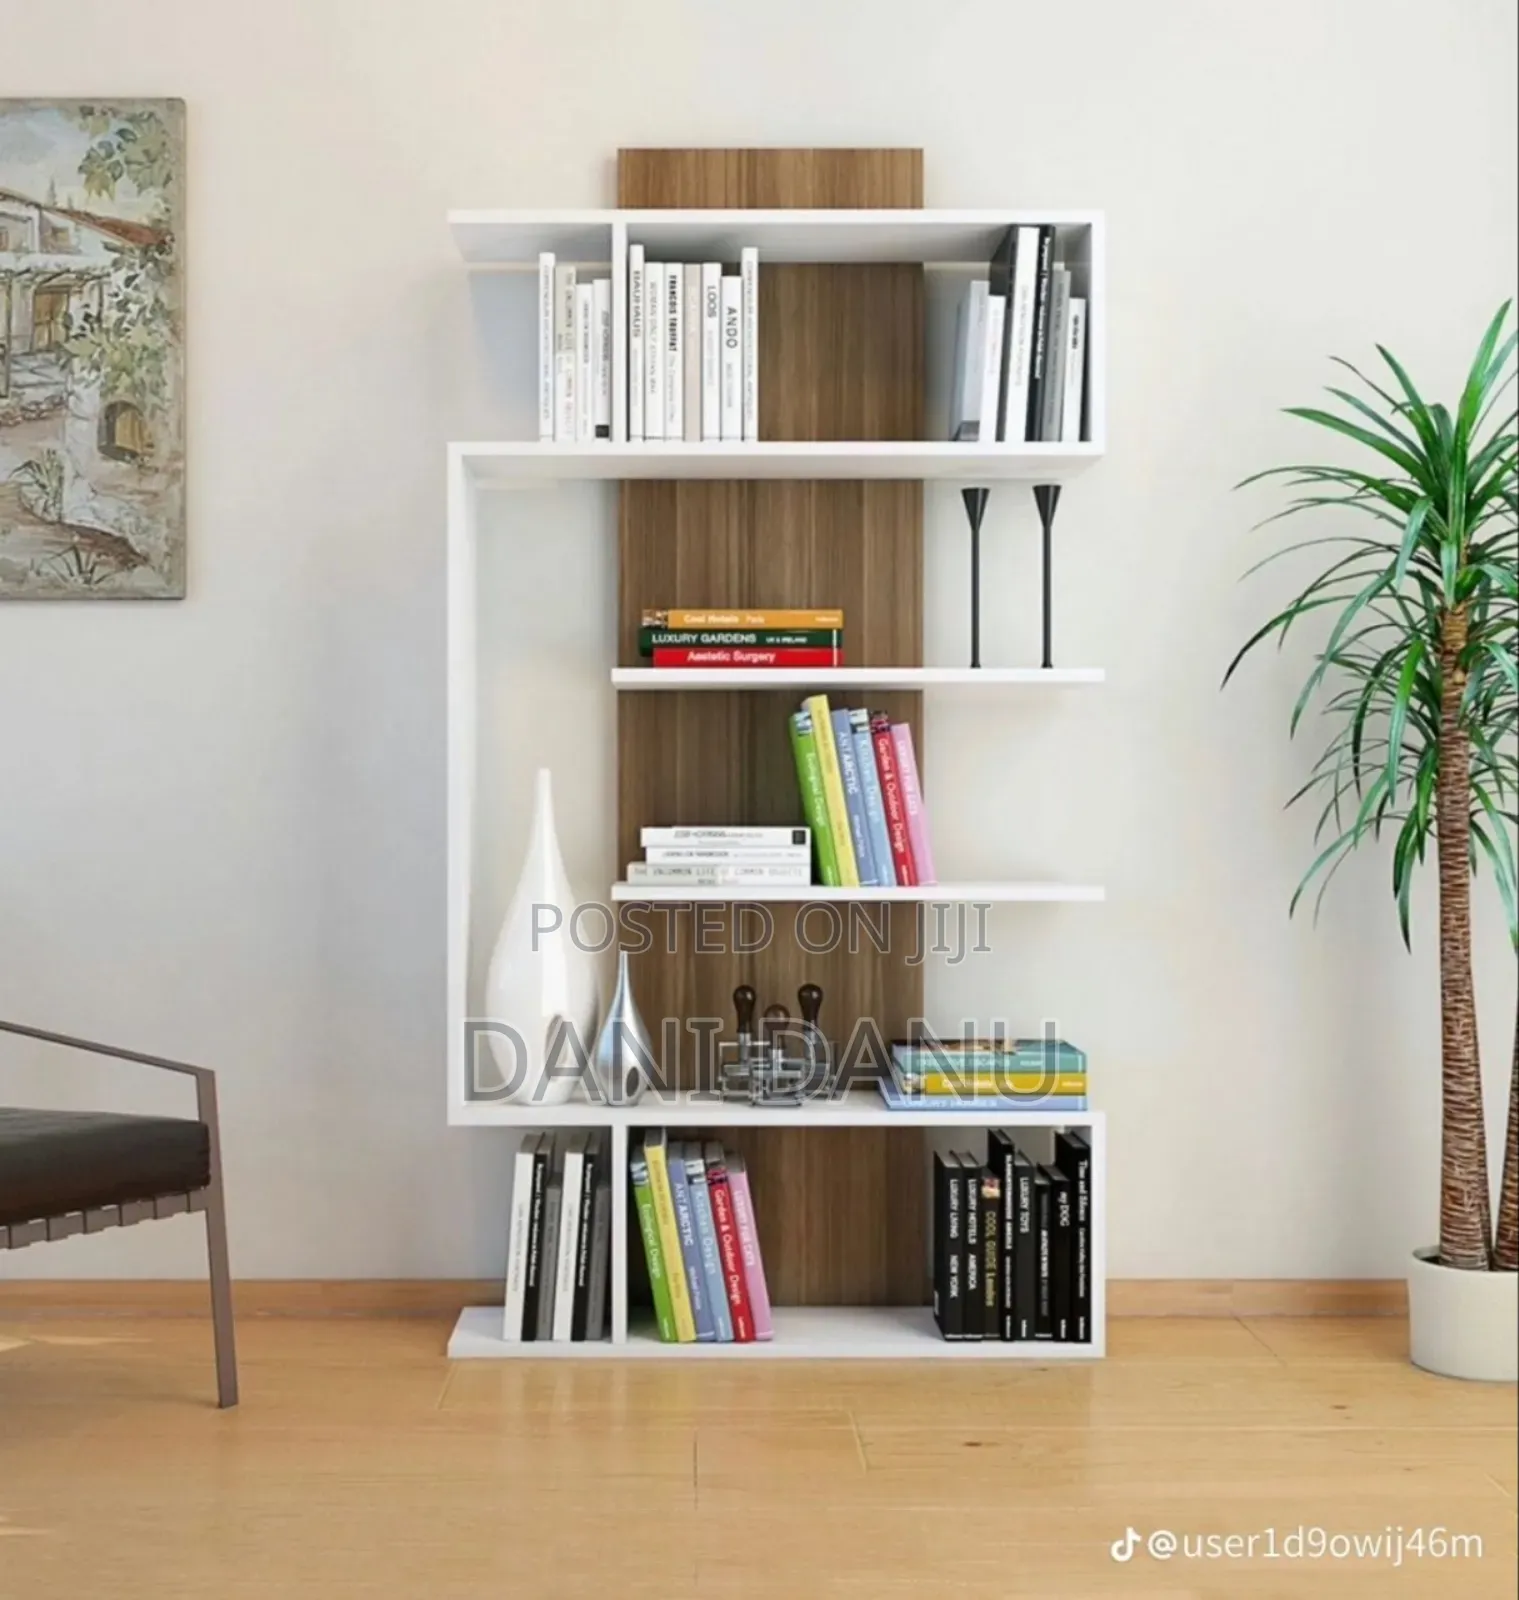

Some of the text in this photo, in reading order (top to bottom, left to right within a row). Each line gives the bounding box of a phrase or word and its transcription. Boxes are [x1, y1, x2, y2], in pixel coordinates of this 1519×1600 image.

[632, 270, 642, 338] BAUHAUS
[668, 274, 678, 315] FRANCOIS
[706, 285, 717, 318] LOOS
[725, 305, 738, 349] ANDO
[651, 633, 699, 645] LUXURY
[700, 633, 757, 645] GARDENS
[732, 650, 776, 664] Surgery
[839, 731, 859, 796] ANTARCTIC
[806, 752, 826, 827] Ecological Design
[866, 785, 880, 823] Design
[879, 738, 891, 771] Garden
[886, 782, 899, 821] Outdoor
[893, 823, 906, 853] Design
[1078, 1159, 1088, 1178] Time
[1078, 1180, 1087, 1194] and
[674, 1182, 694, 1247] ANTARCTIC
[985, 1210, 996, 1237] COOL
[1019, 1176, 1029, 1233] LUXURY TOYS
[1059, 1204, 1070, 1227] DOG
[641, 1202, 662, 1278] Ecological Design
[695, 1190, 718, 1276] Kitchen Design
[714, 1189, 727, 1224] Garden
[722, 1233, 736, 1273] Outdoor
[729, 1274, 743, 1307] Design
[740, 1225, 752, 1243] FOR
[949, 1178, 959, 1299] LUXURY LIVING NEW YORK
[967, 1178, 977, 1290] LUXURY HOTELS AMERICA
[742, 1242, 756, 1267] CATS
[985, 1240, 996, 1270] GUIDE
